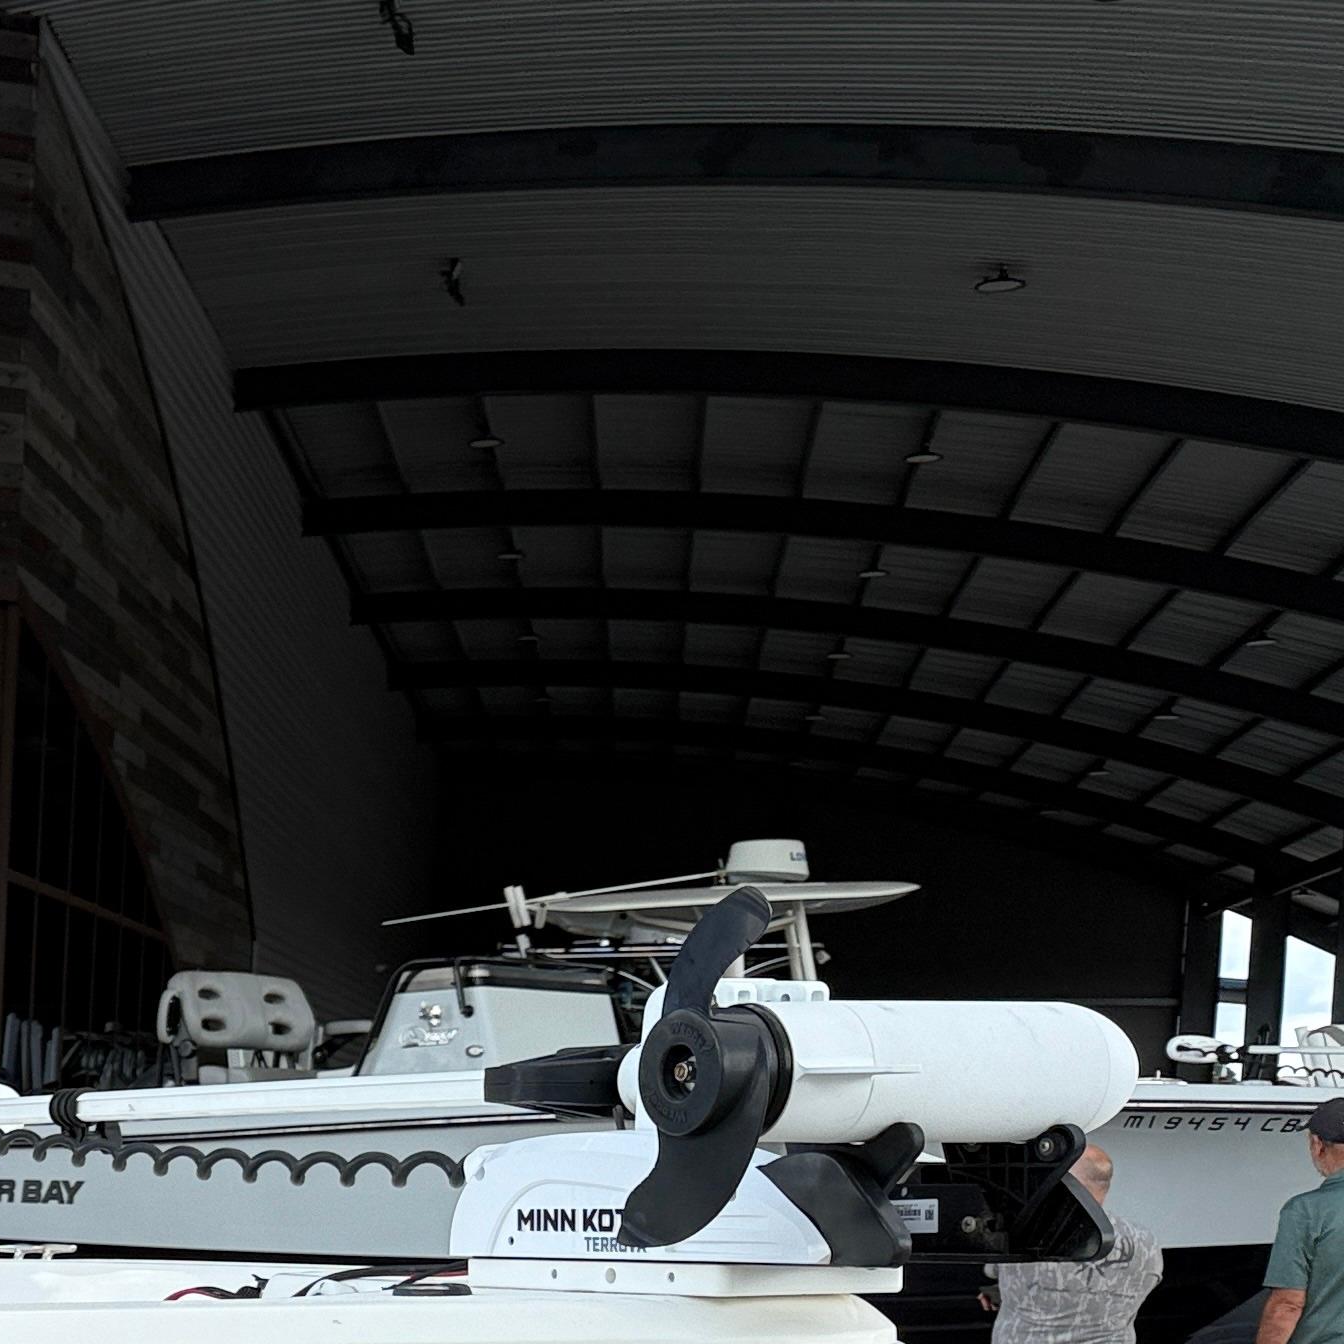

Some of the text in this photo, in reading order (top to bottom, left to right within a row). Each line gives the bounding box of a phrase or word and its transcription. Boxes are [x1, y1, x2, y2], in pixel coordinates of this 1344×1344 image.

[1123, 1114, 1156, 1129] MI
[1163, 1116, 1252, 1132] 9454
[20, 1179, 86, 1205] BAY
[516, 1208, 576, 1232] MINN
